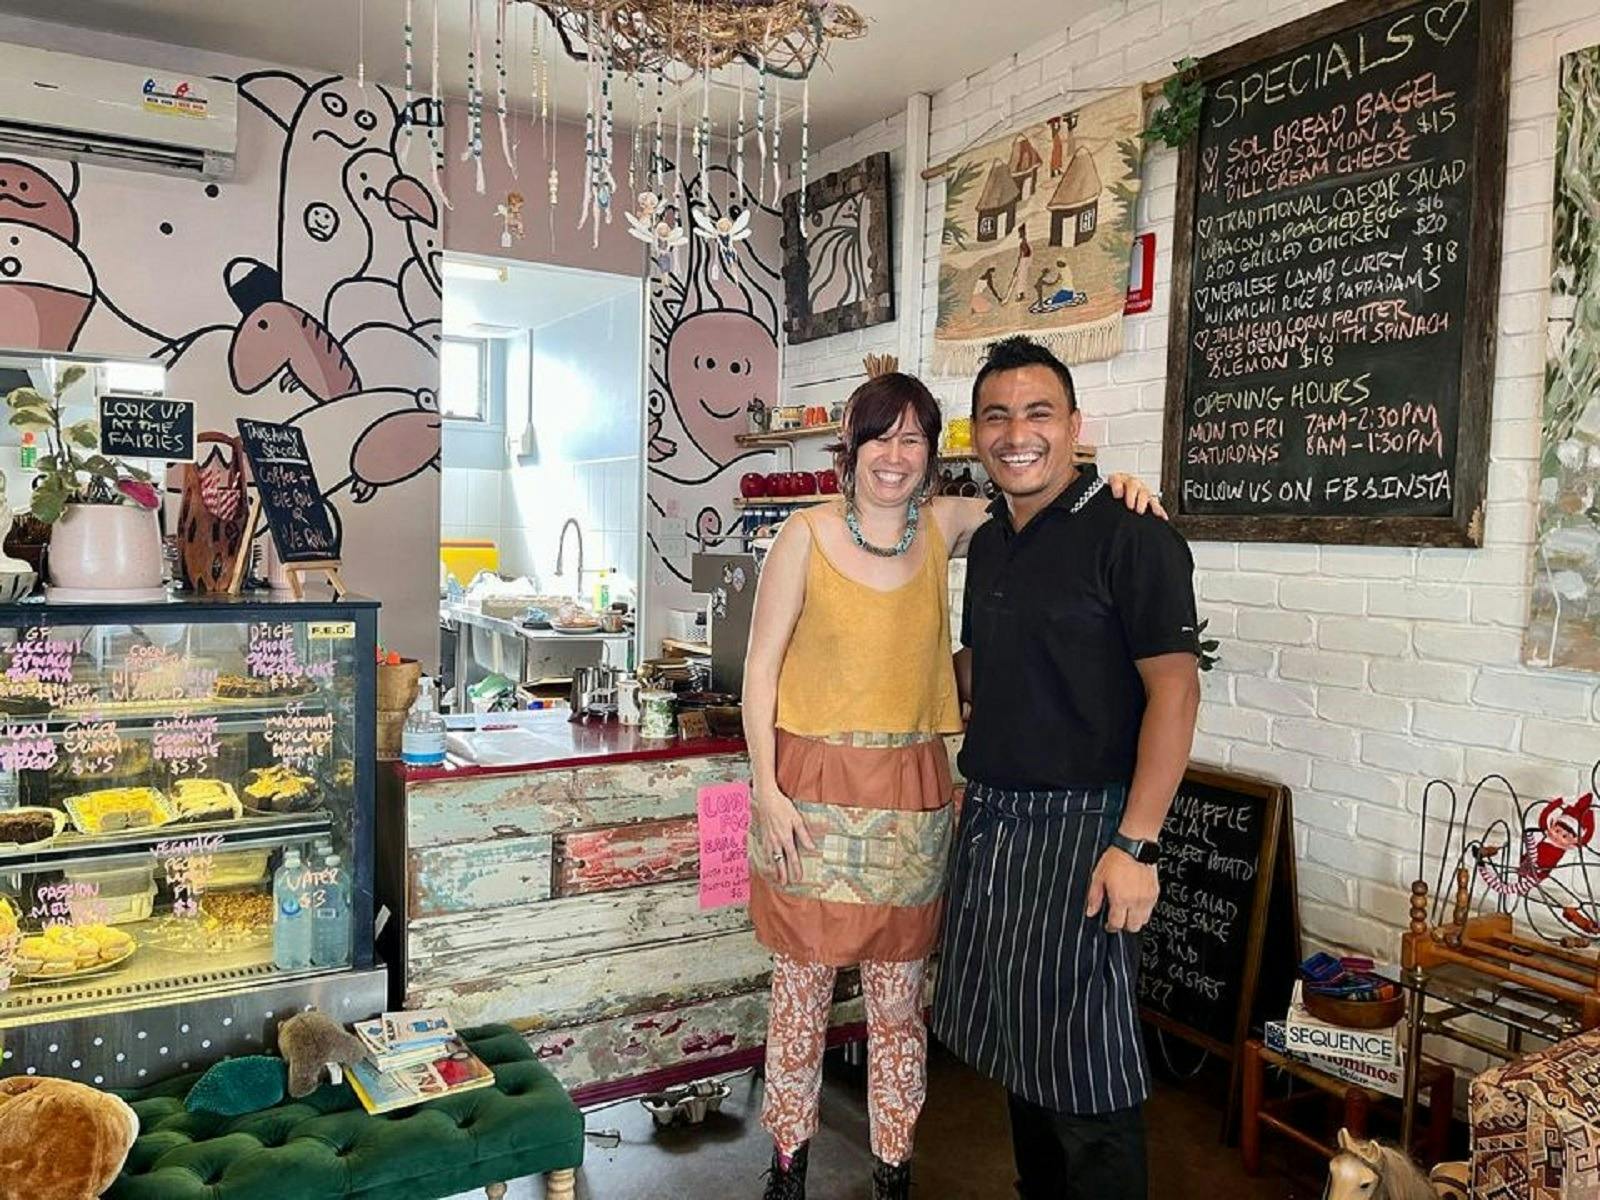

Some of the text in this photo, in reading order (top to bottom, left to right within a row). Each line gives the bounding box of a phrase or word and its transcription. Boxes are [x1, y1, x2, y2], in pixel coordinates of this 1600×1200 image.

[1213, 14, 1415, 127] SPECIALS
[1228, 72, 1456, 163] SOL BREAD BAGEL
[1417, 103, 1456, 134] $15
[1224, 148, 1293, 187] SMOKED
[1295, 121, 1378, 166] SALMON
[1226, 134, 1417, 203] DILL CREAM CHEESE
[1217, 160, 1466, 233] TRADITIONAL CAESAR SALAD
[1416, 192, 1443, 213] $16
[1412, 213, 1448, 236] $20
[1240, 242, 1302, 273] GRILLED
[1308, 225, 1390, 254] CHICKEN
[1422, 240, 1459, 265] $18
[1212, 246, 1408, 304] NEPALESE LAMB CURRY
[1336, 264, 1441, 303] PAPPADAMS
[1286, 309, 1326, 335] CORN
[1332, 300, 1412, 324] FRITTER
[1247, 331, 1308, 356] BENNY
[1319, 324, 1366, 345] WITH
[1372, 312, 1448, 343] SPINACH
[1299, 344, 1334, 370] $18
[103, 402, 185, 419] LOOK UP
[1194, 373, 1371, 418] OPENING HOURS
[108, 432, 184, 452] FAIRIES
[112, 420, 175, 433] AT THE
[1188, 421, 1226, 443] MON
[1229, 421, 1249, 440] TO
[1254, 418, 1284, 439] FRI
[1188, 441, 1281, 466] SATURDAYS
[1184, 479, 1245, 503] FOLLOW
[1249, 480, 1272, 502] US
[1279, 477, 1312, 502] ON
[26, 626, 53, 641] GF
[38, 880, 99, 904] PASSION
[1191, 889, 1239, 921] SALAD
[1289, 1026, 1392, 1058] SEQUENCE
